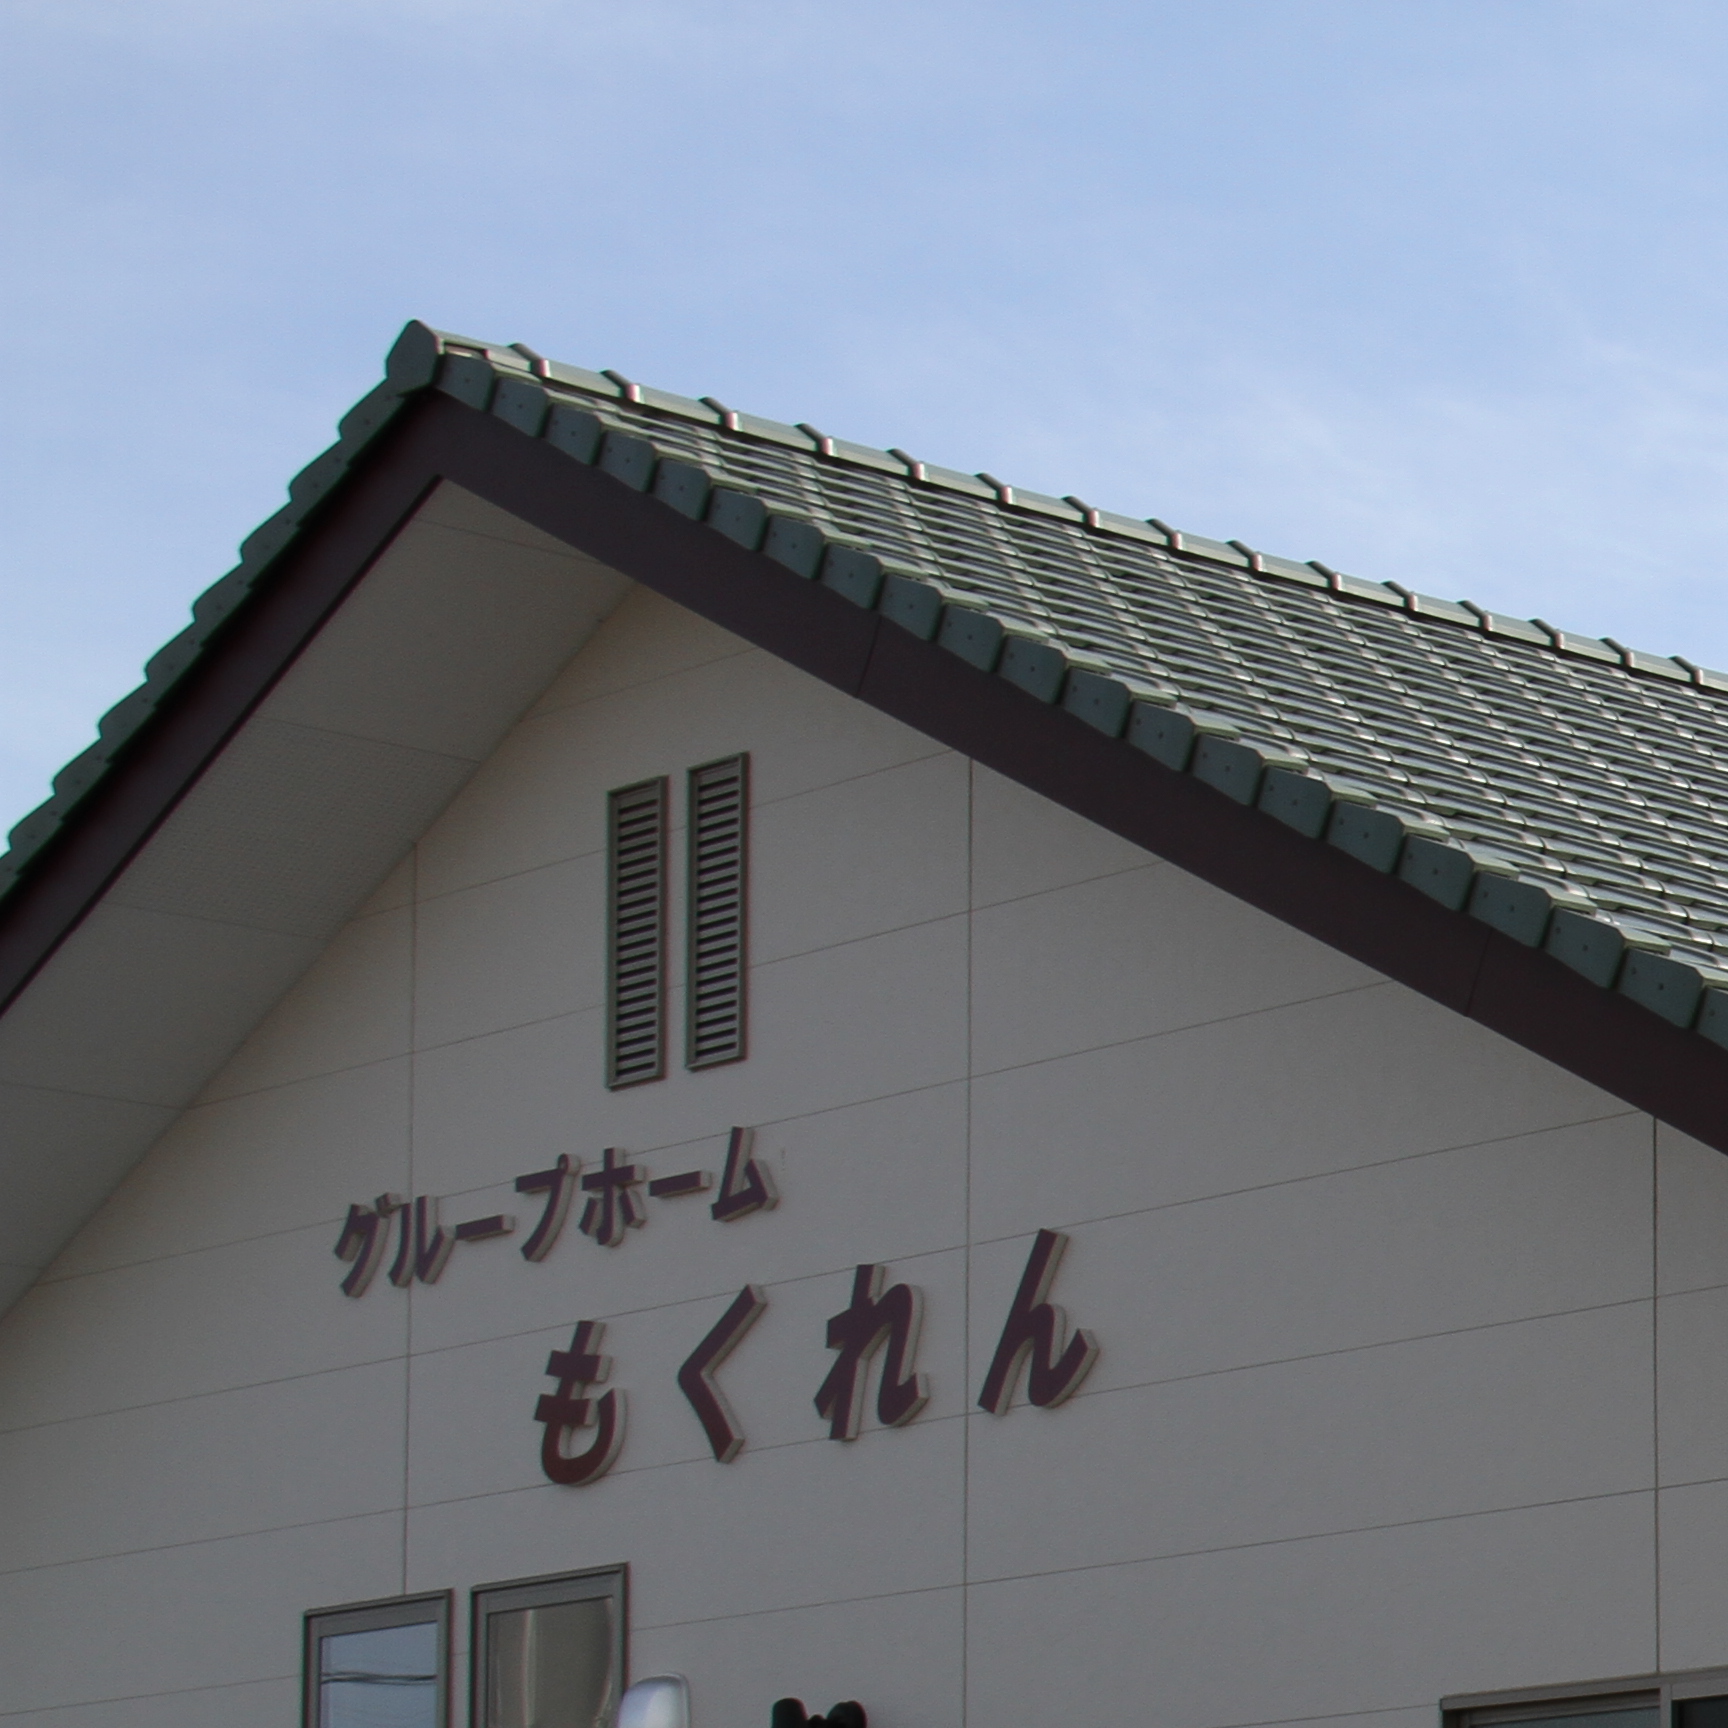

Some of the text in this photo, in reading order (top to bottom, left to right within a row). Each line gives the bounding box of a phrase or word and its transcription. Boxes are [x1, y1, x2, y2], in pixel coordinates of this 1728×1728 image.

[334, 1125, 779, 1298] グループホーム
[534, 1228, 1099, 1486] もくれん
